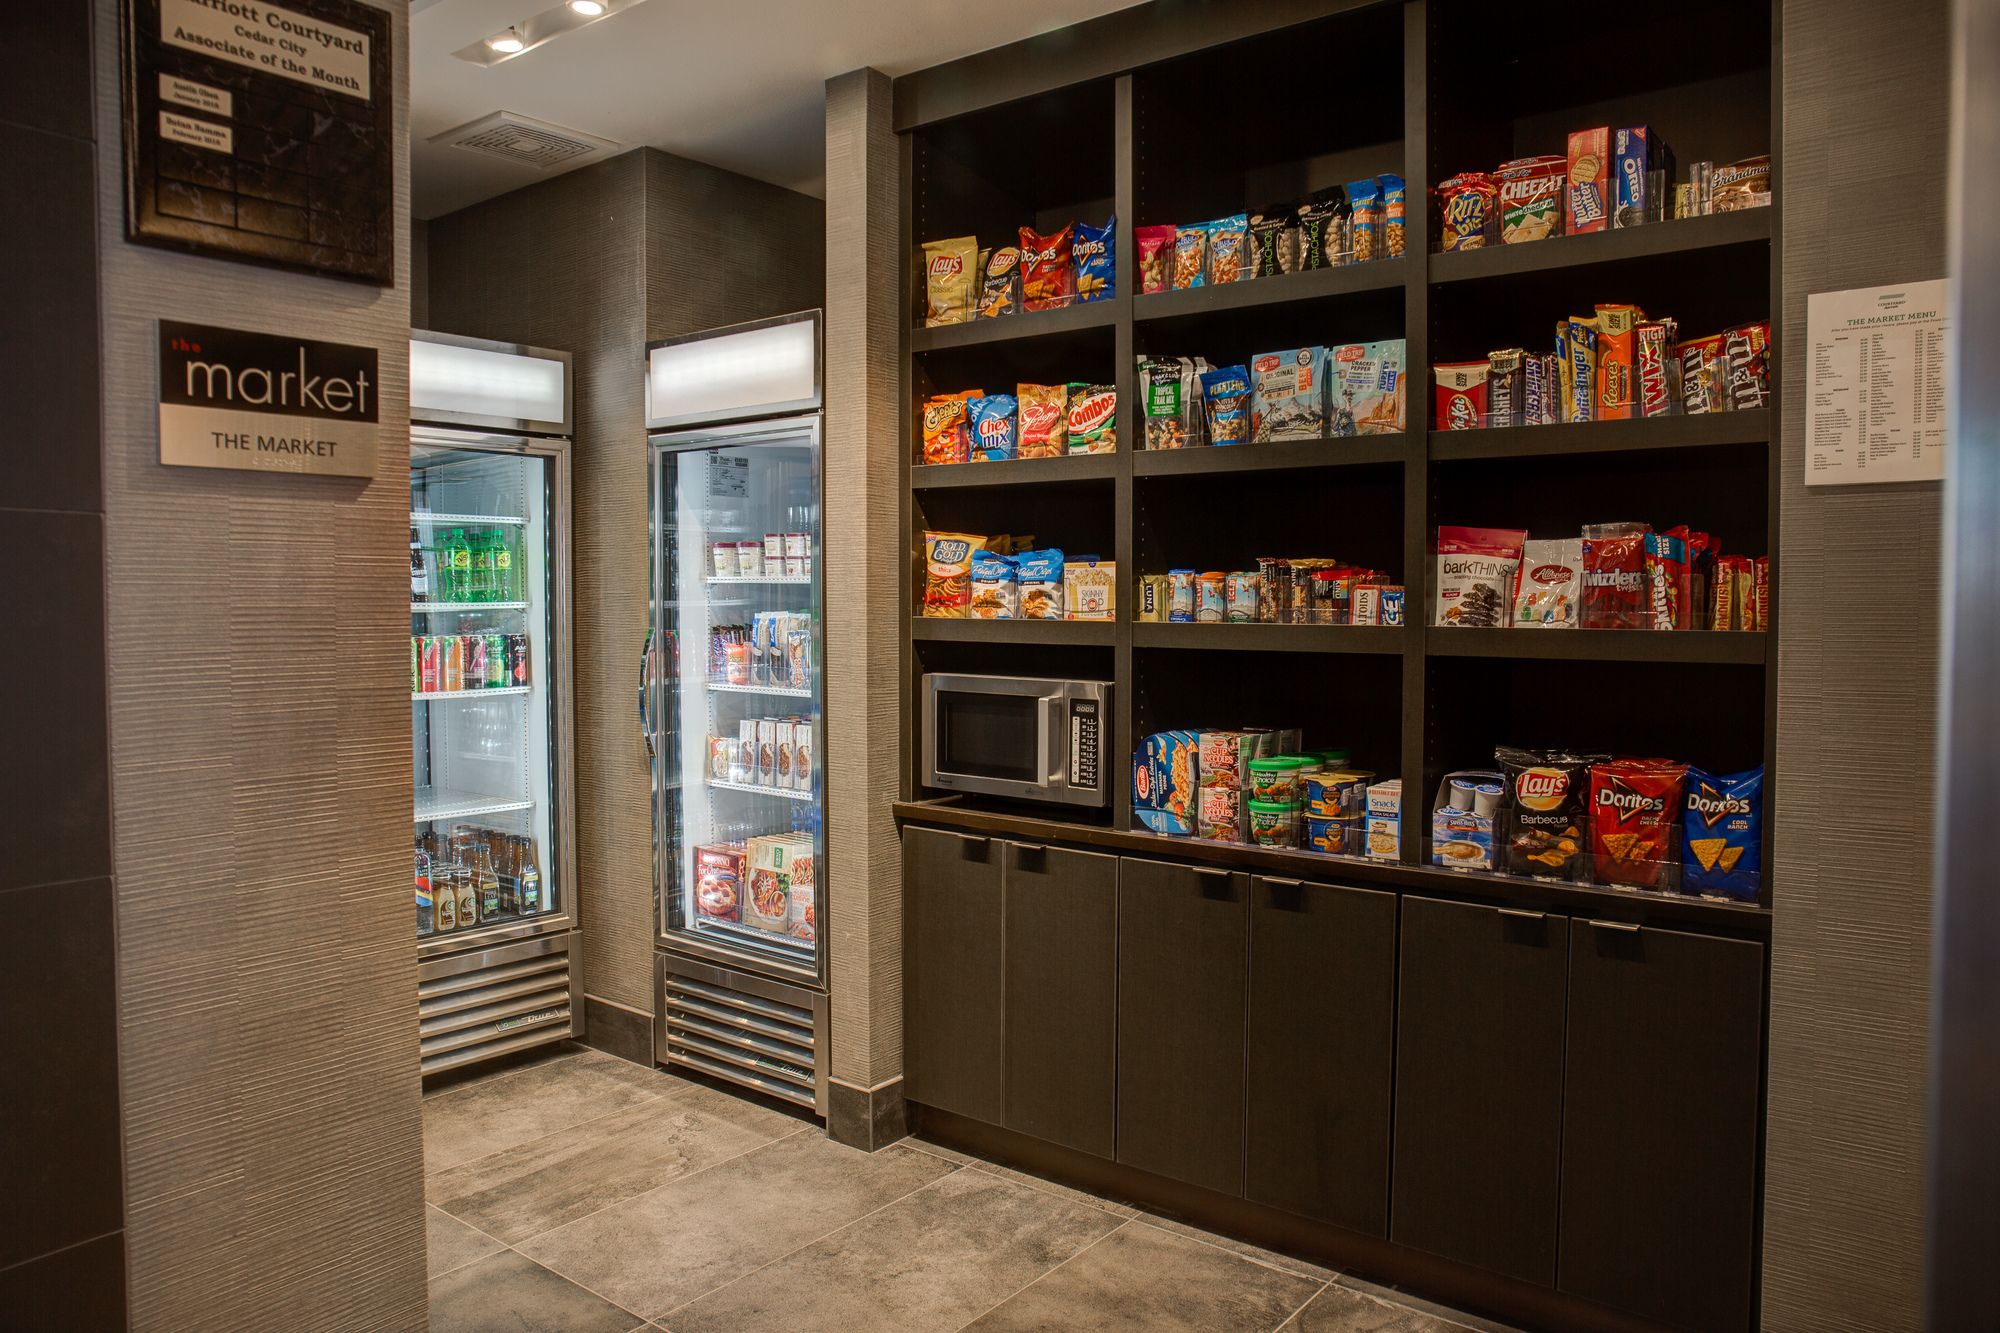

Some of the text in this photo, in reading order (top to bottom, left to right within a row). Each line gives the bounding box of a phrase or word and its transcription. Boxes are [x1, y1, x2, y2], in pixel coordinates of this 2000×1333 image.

[190, 0, 364, 56] rriott Courtyard
[234, 24, 307, 57] Cedar City
[174, 26, 360, 92] Associate of the Month
[1623, 158, 1640, 202] OREO
[1264, 230, 1274, 277] ISTACHIOS
[1867, 314, 1906, 324] MARKET
[1908, 311, 1937, 320] MENU
[171, 337, 202, 353] the
[186, 346, 369, 413] market
[1069, 395, 1115, 427] Combos
[979, 419, 1010, 436] Chex
[211, 432, 337, 457] THE MARKET
[934, 548, 964, 561] GOLD
[939, 541, 966, 550] ROLD
[1444, 560, 1509, 578] barkTHINS
[1582, 568, 1642, 587] Twizzlers
[1081, 589, 1104, 598] SKINNY
[1204, 753, 1234, 764] NOODLES
[1371, 799, 1395, 808] Snack
[1600, 789, 1663, 811] Doritos
[1687, 793, 1750, 813] Doritos
[1204, 806, 1234, 817] NOODLES
[1520, 814, 1568, 825] Barbecue
